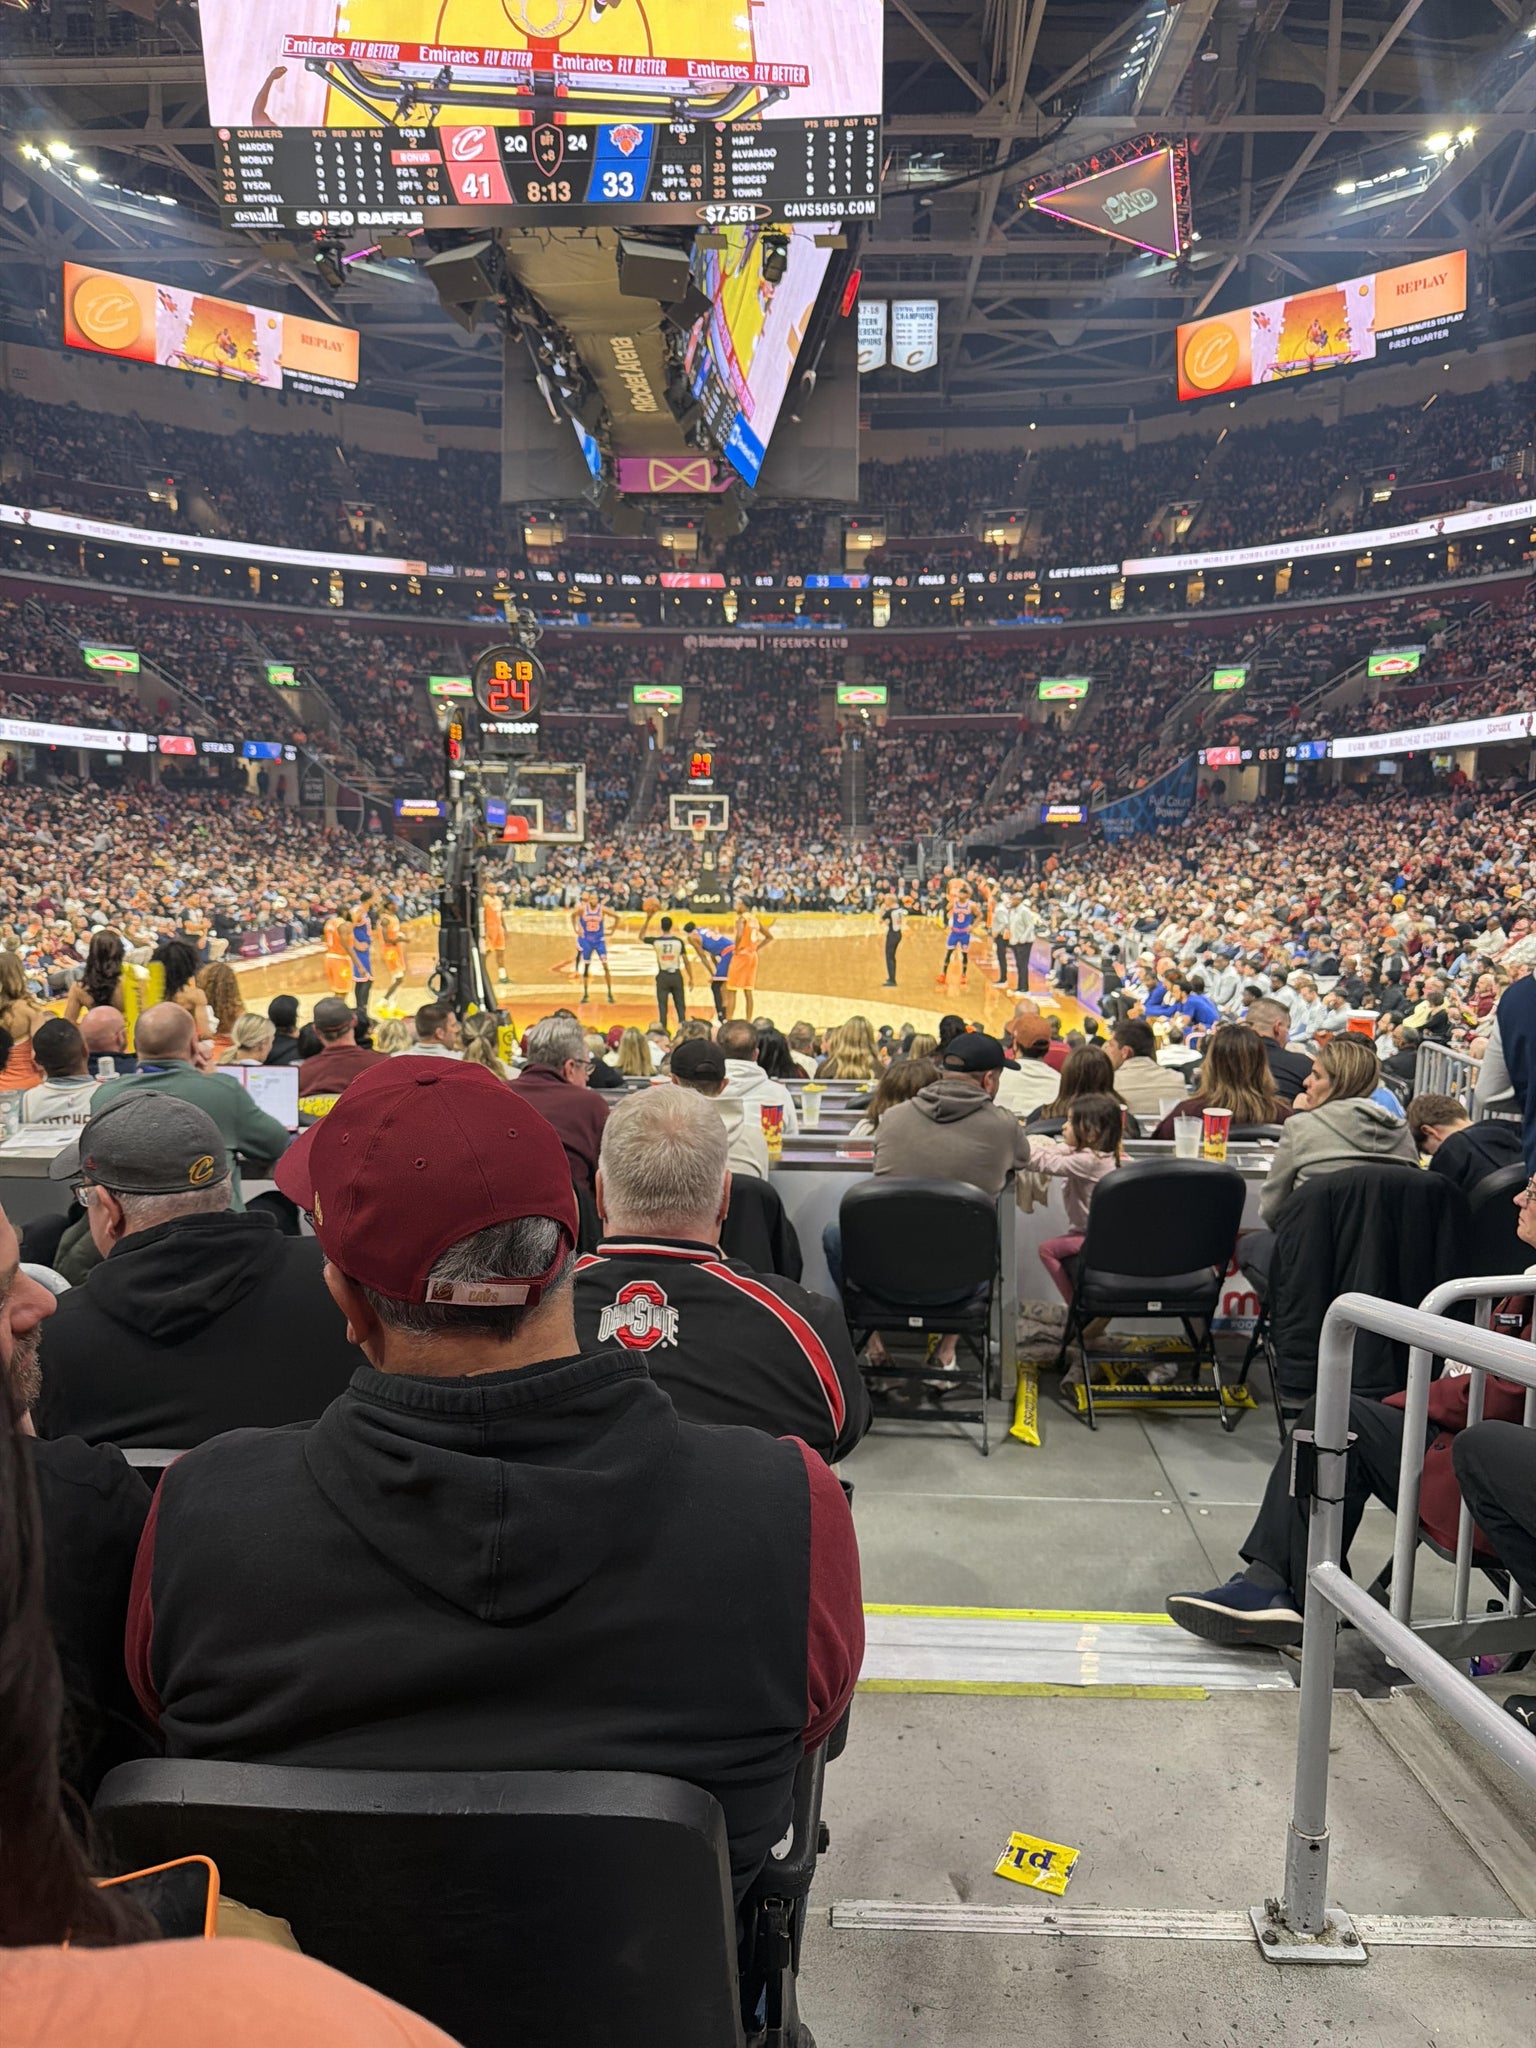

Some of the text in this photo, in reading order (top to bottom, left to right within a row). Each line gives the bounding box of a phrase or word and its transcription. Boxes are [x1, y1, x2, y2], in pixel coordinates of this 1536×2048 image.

[284, 38, 399, 60] Emirates FLY BETTER
[419, 46, 533, 67] Emirates FLY BETTER
[552, 53, 667, 75] Emirates FLY BETTER
[687, 60, 806, 83] Emirates FLY BETTER
[669, 124, 696, 134] FOULS
[731, 117, 878, 132] KNICKS PTS REB AST FLS
[237, 130, 383, 139] CAVALIERS PTS REB AST FLS
[400, 129, 426, 138] FOULS
[678, 134, 687, 145] 5
[731, 135, 755, 145] HART
[238, 142, 274, 152] HARDEN
[409, 138, 417, 149] 2
[504, 136, 528, 153] 2Q
[567, 134, 588, 151] 24
[239, 155, 274, 165] MOBLEY
[400, 152, 431, 163] BONUS
[731, 148, 777, 159] ALVARADO
[240, 168, 263, 178] ELLIS
[732, 162, 775, 172] ROBINSON
[242, 181, 271, 191] TYSON
[461, 172, 492, 199] 41
[602, 171, 634, 198] 33
[732, 175, 767, 185] BRIDGES
[243, 194, 284, 204] MITCHELL
[527, 181, 572, 203] 8:13
[732, 187, 763, 198] TOWNS
[234, 206, 279, 223] oswald
[706, 205, 756, 224] $7,561
[784, 201, 876, 217] CAVS5050.COM
[357, 211, 423, 225] RAFFLE
[1395, 273, 1448, 297] REPLAY
[301, 333, 344, 352] REPLAY
[1389, 329, 1449, 350] FIRST QUARTER
[609, 336, 643, 372] Arena
[767, 637, 817, 649] EGENDS
[495, 661, 533, 681] 8:13
[488, 678, 530, 712] 24
[497, 722, 539, 734] TISSOT
[630, 1297, 680, 1346] STATE
